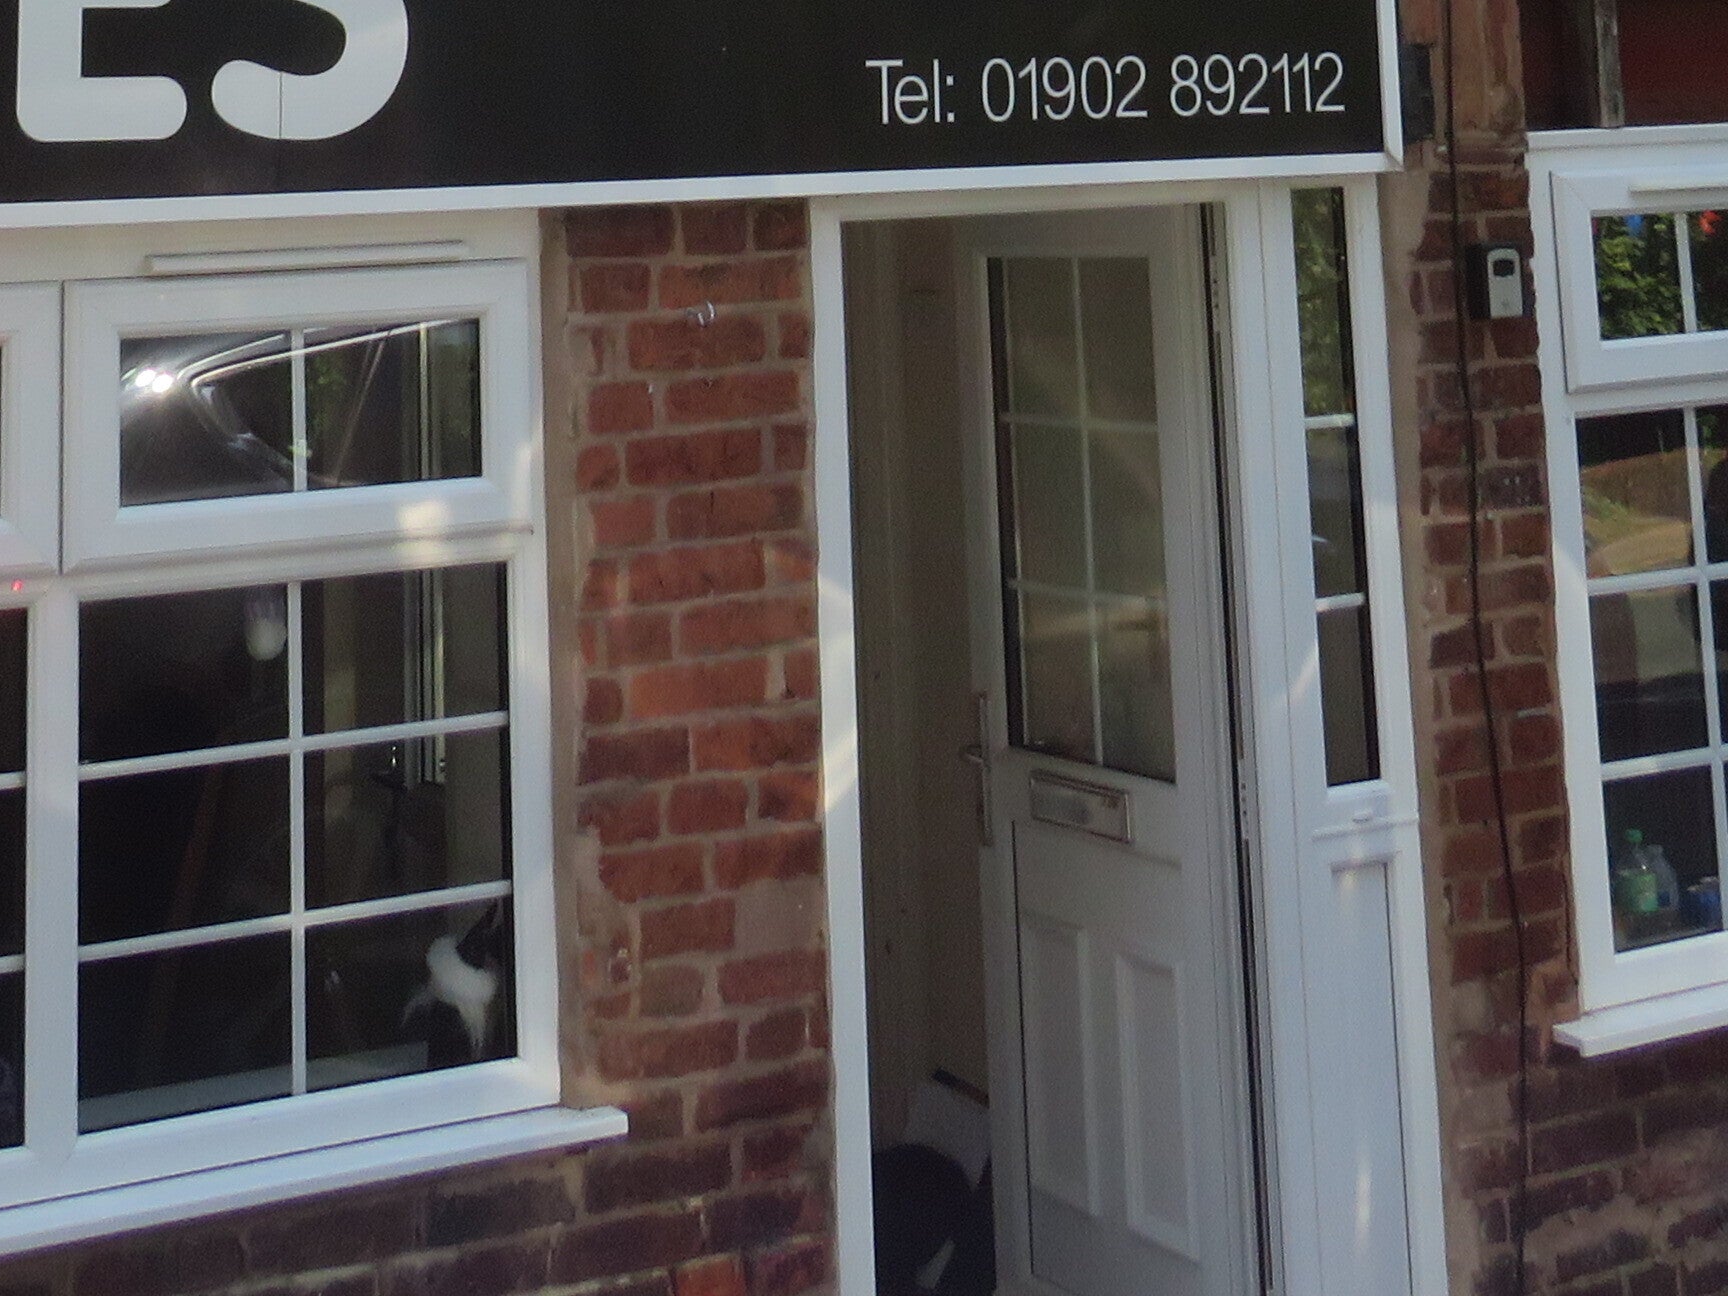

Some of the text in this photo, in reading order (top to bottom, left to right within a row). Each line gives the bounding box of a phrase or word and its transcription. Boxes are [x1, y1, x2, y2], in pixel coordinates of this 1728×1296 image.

[865, 51, 1346, 126] Tel: 01902 892112
